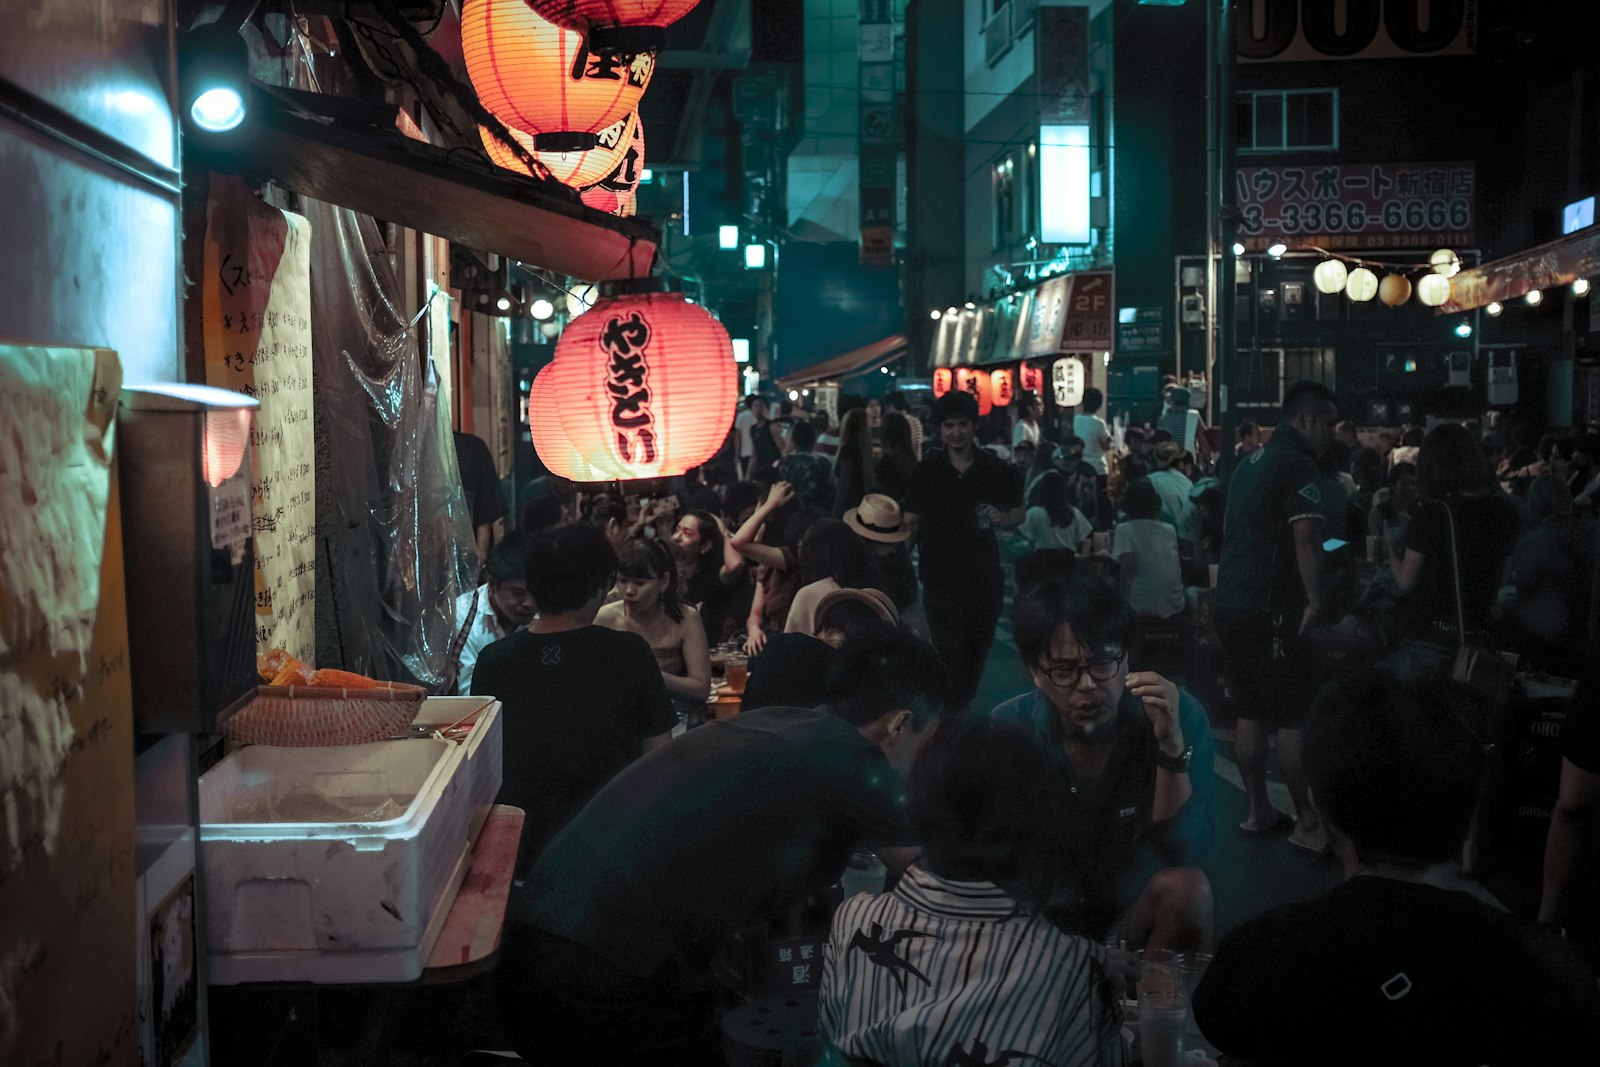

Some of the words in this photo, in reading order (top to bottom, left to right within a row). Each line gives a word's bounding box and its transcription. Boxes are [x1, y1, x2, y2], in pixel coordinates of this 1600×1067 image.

[1237, 198, 1470, 235] 3-3366-6666
[1075, 295, 1106, 312] 2F
[602, 311, 658, 464] やきとり
